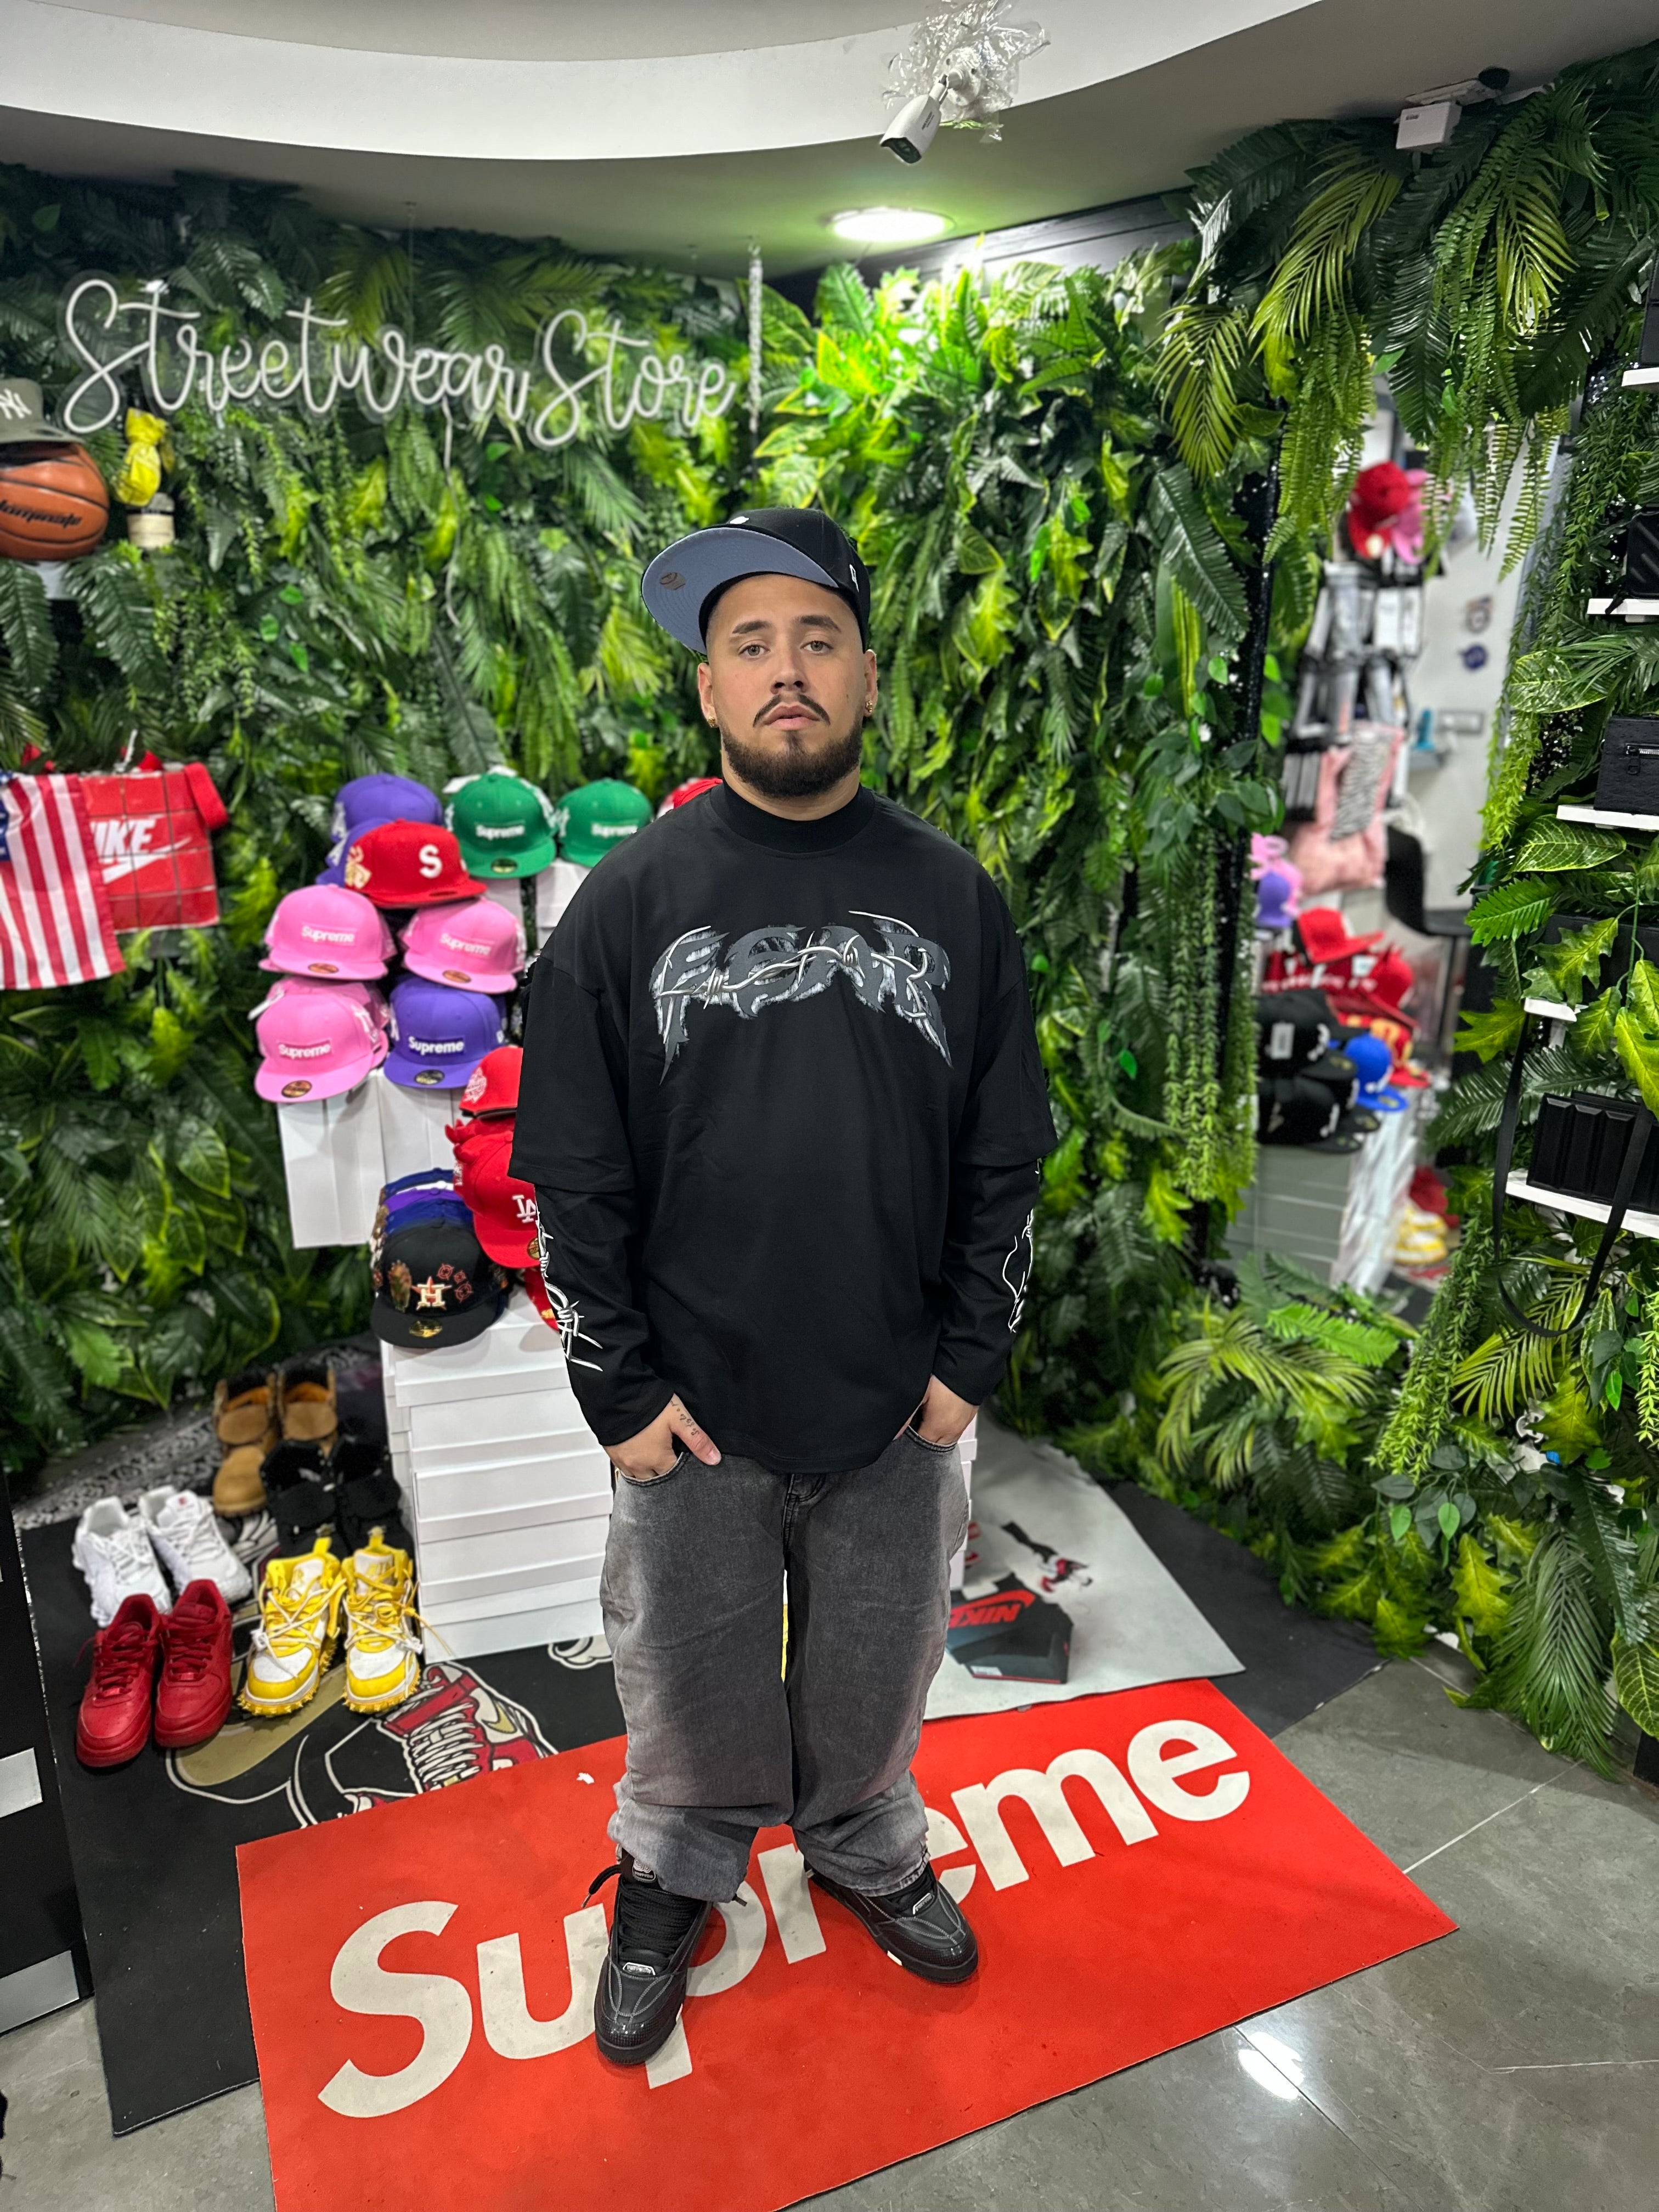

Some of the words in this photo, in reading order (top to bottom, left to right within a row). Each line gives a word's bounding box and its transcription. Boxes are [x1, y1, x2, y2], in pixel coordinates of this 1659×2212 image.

[64, 279, 529, 433] Streetwear
[533, 309, 736, 447] Store
[419, 844, 443, 879] S
[301, 926, 355, 943] Supreme
[440, 933, 492, 956] Supreme
[278, 1043, 331, 1060] Supreme
[408, 1036, 465, 1056] Supreme
[512, 1194, 537, 1224] LA
